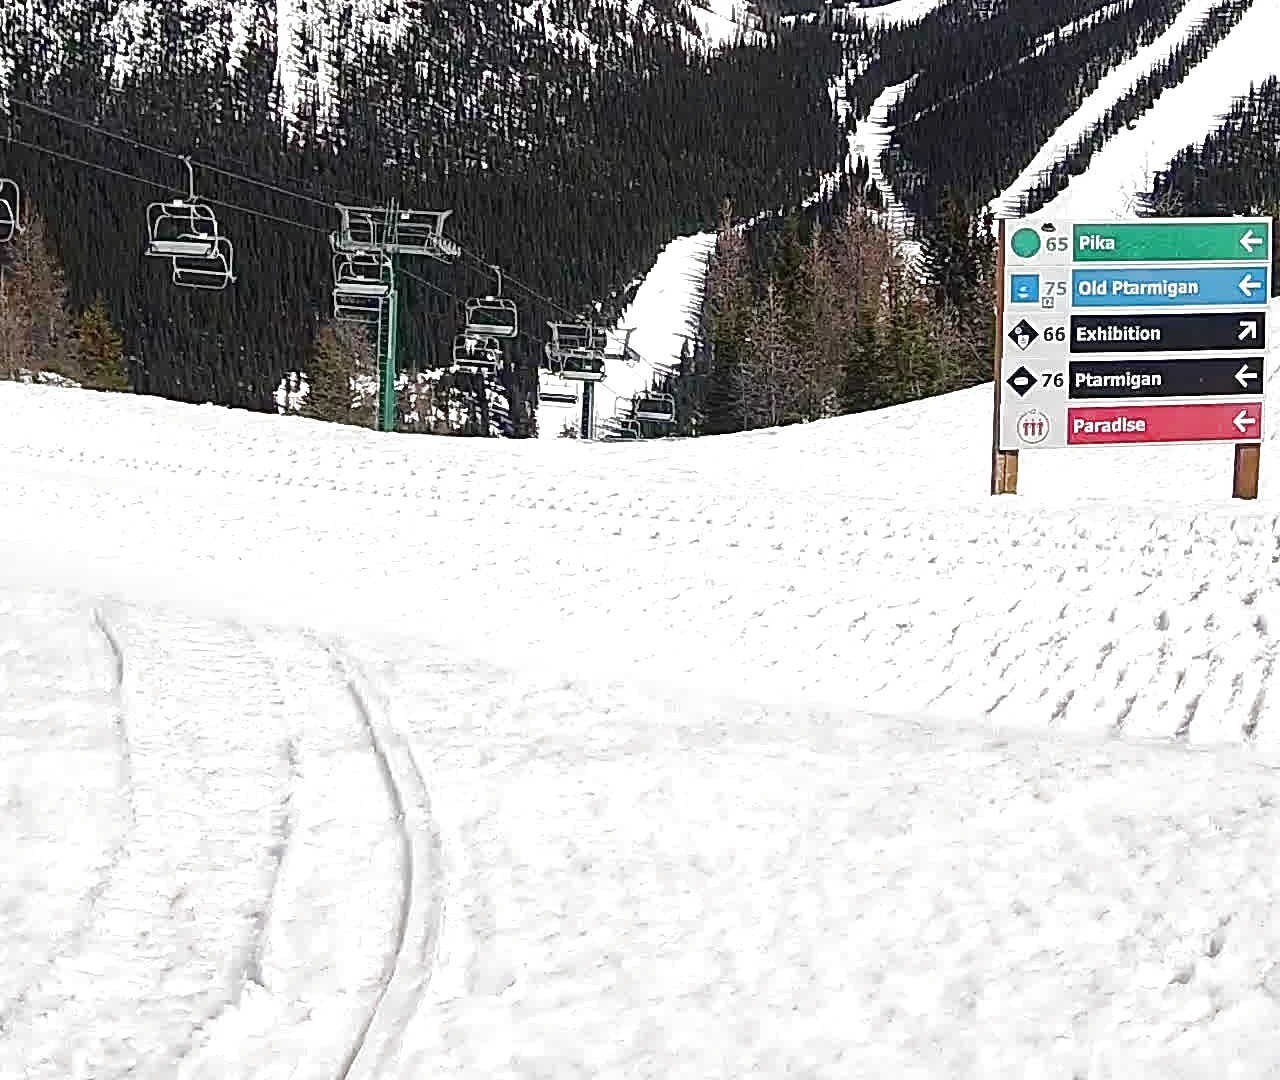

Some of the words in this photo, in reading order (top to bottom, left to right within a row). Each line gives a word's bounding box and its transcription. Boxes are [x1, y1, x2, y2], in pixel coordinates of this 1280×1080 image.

[1046, 237, 1068, 252] 65
[1079, 235, 1115, 251] Pika
[1044, 282, 1067, 296] 75
[1078, 279, 1107, 296] Old
[1112, 278, 1199, 298] Ptarmigan
[1043, 327, 1066, 342] 66
[1076, 325, 1161, 342] Exhibition
[1041, 373, 1064, 388] 76
[1075, 370, 1162, 391] Ptarmigan
[1073, 417, 1146, 434] Paradise
